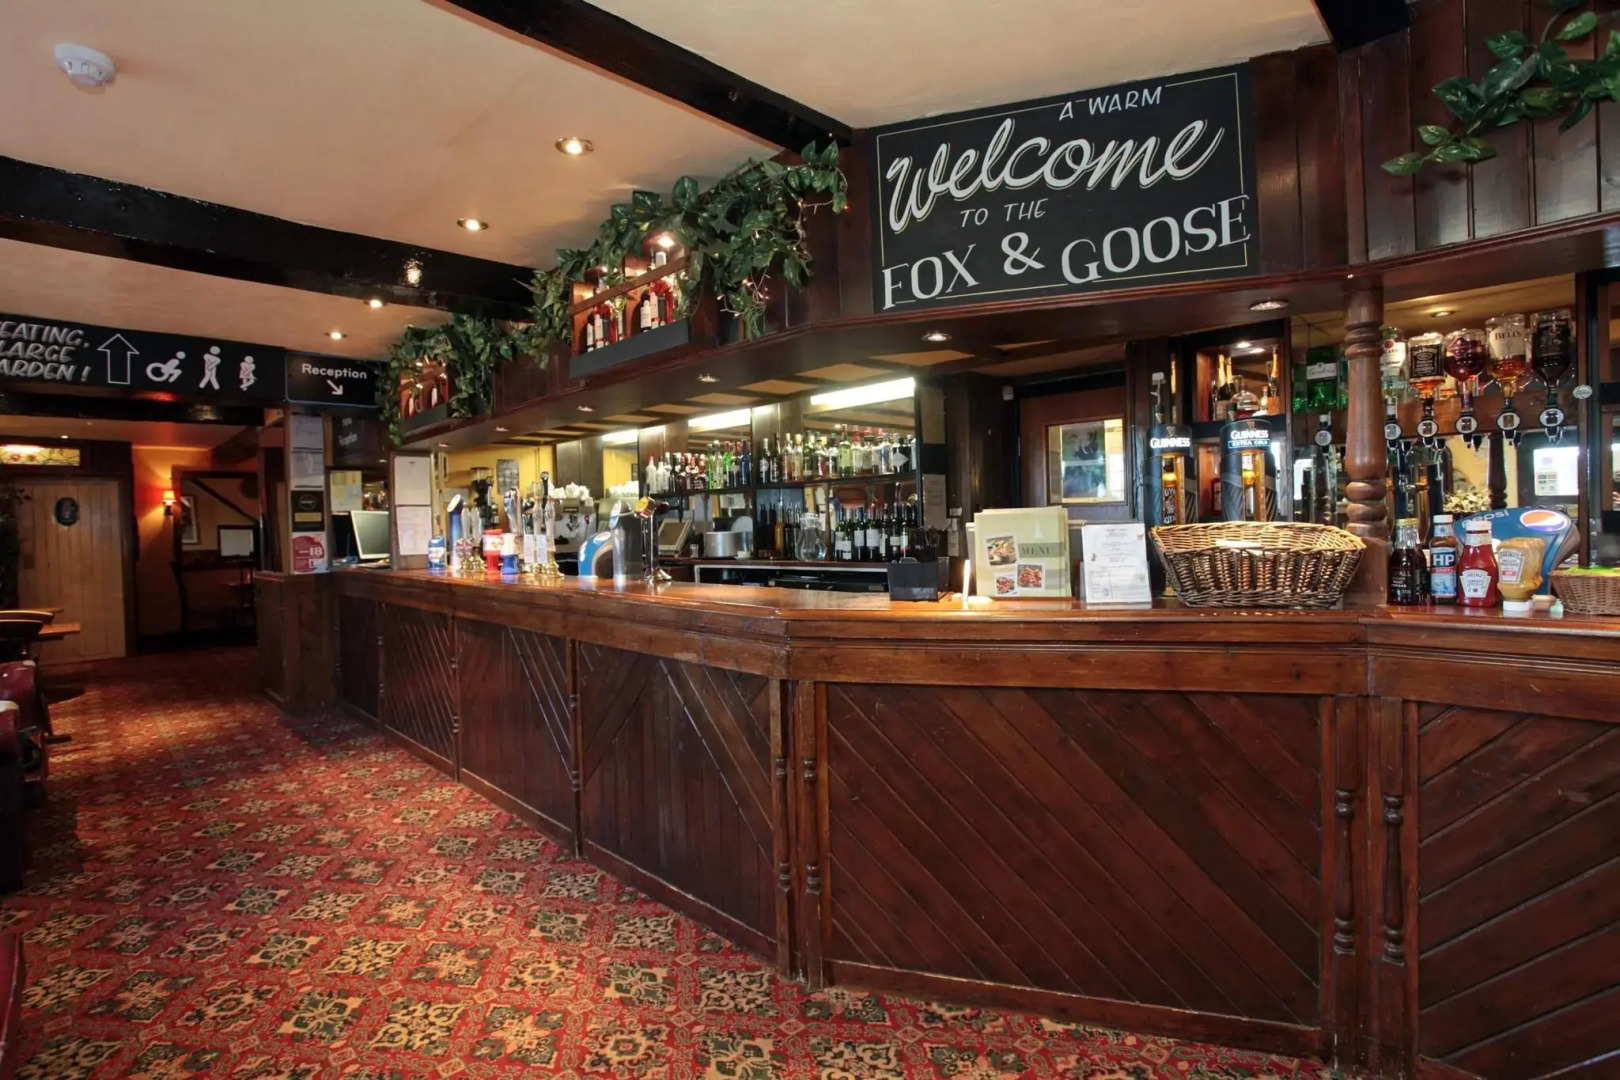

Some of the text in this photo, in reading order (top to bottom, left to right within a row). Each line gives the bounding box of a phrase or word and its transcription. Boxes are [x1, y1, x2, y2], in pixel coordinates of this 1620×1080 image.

[1059, 86, 1163, 121] A WARM
[886, 117, 1225, 235] Welcome
[960, 198, 1048, 228] TO THE
[881, 194, 1252, 310] FOX & GOOSE
[301, 362, 368, 379] Reception
[1150, 437, 1191, 449] GUINNESS
[1231, 429, 1269, 440] GUINNESS
[1432, 554, 1455, 567] HP
